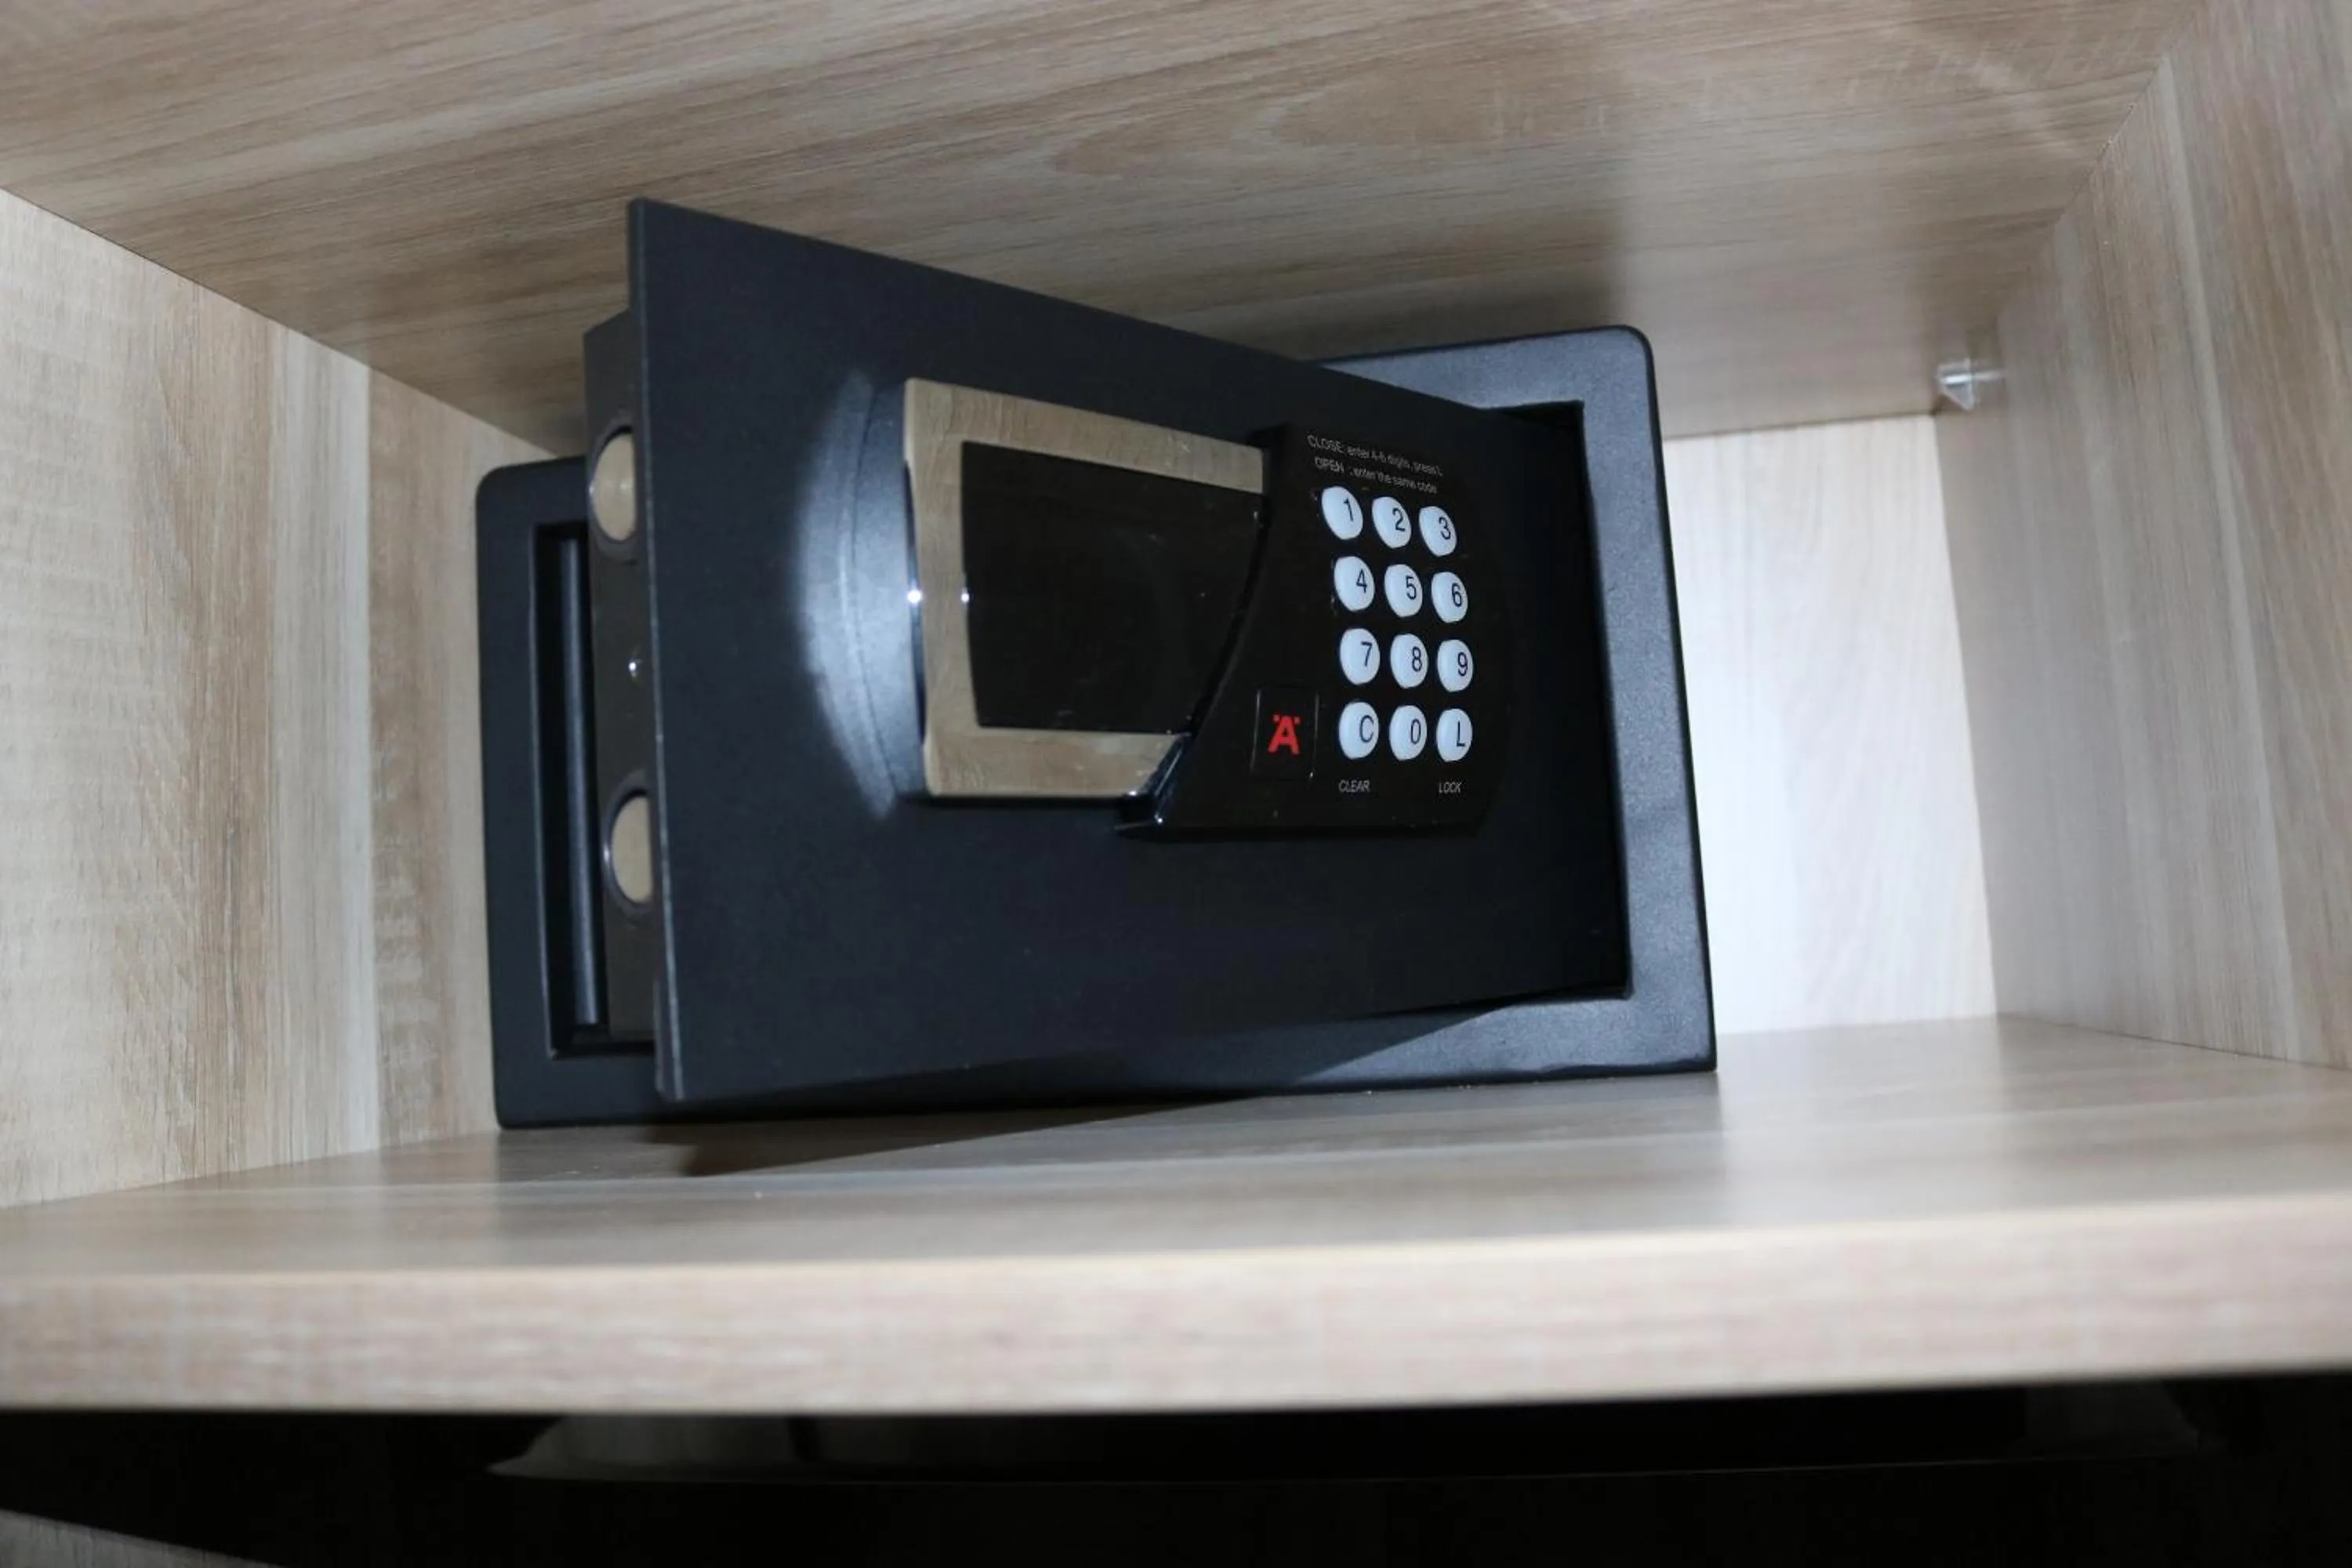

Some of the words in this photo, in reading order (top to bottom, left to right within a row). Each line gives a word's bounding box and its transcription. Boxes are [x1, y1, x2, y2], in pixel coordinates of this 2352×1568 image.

[1315, 456, 1345, 474] OPEN
[1392, 476, 1417, 490] same
[1343, 498, 1355, 522] 1
[1392, 507, 1406, 532] 2
[1438, 516, 1452, 541] 3
[1356, 568, 1369, 594] 4
[1405, 575, 1417, 601] 5
[1451, 583, 1463, 608] 6
[1361, 641, 1373, 667] 7
[1410, 645, 1423, 673] 8
[1457, 651, 1469, 677] 9
[1359, 714, 1374, 743] C
[1410, 718, 1421, 745] 0
[1456, 720, 1466, 748] L
[1338, 780, 1370, 793] CLEAR
[1438, 782, 1461, 793] LOCK
